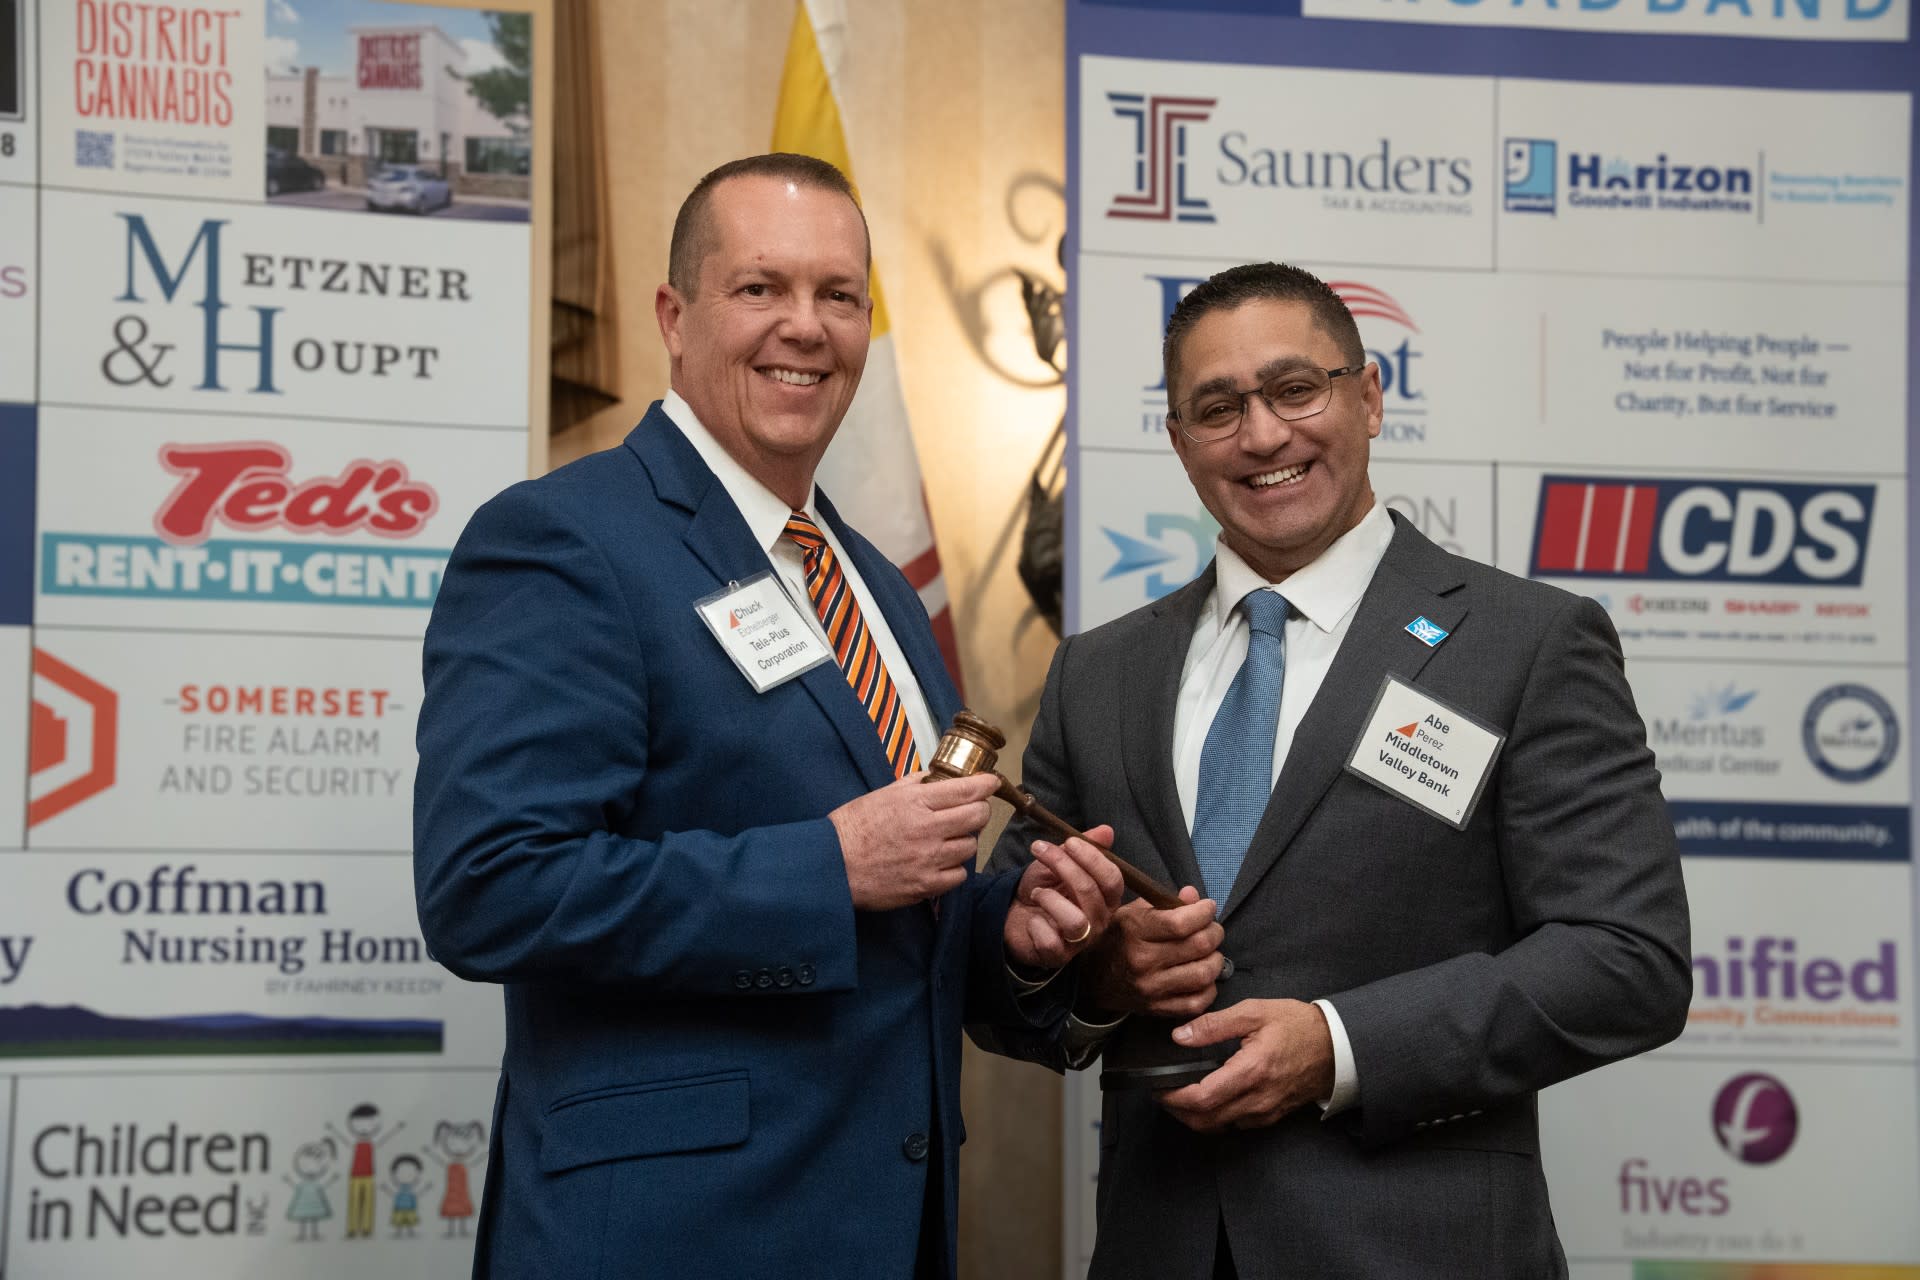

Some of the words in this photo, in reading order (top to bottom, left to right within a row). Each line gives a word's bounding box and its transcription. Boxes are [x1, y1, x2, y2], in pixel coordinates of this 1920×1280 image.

[76, 0, 234, 67] DISTRICT
[75, 58, 234, 127] CANNABIS
[1217, 131, 1473, 197] Saunders
[1569, 153, 1752, 194] Horizon
[1321, 194, 1349, 208] TAX
[1369, 197, 1473, 216] ACCOUNTING
[1568, 191, 1653, 208] Goodwill
[1657, 195, 1752, 212] Industries
[100, 314, 177, 389] &
[1602, 331, 1669, 355] People
[1674, 332, 1752, 357] Helping
[1756, 335, 1820, 360] People
[1624, 362, 1661, 381] Not
[1665, 360, 1694, 382] for
[1700, 362, 1756, 385] Profit,
[1762, 365, 1795, 385] Not
[1799, 365, 1828, 387] for
[1614, 391, 1694, 417] Charity,
[1697, 394, 1731, 414] But
[1735, 394, 1763, 415] for
[1767, 397, 1837, 418] Service
[1382, 421, 1426, 443] ION
[157, 444, 437, 542] Ted's
[1659, 487, 1865, 580] CDS
[734, 600, 764, 620] Chuck
[749, 627, 791, 652] Tele-Plus
[757, 640, 808, 670] Corporation
[179, 684, 391, 718] SOMERSET
[182, 724, 257, 755] FIRE
[266, 725, 382, 757] ALARM
[1416, 729, 1445, 751] Perez
[1424, 713, 1450, 735] Abe
[1653, 718, 1765, 748] Meritus
[1385, 731, 1459, 780] Middletown
[1655, 752, 1714, 773] edical
[1719, 754, 1781, 774] Center
[159, 764, 233, 796] AND
[243, 765, 404, 798] SECURITY
[1378, 749, 1414, 780] Valley
[1417, 770, 1452, 797] Bank
[1675, 816, 1717, 839] alth
[1718, 816, 1742, 840] of
[1743, 817, 1776, 841] the
[1777, 820, 1894, 847] community.
[65, 865, 328, 916] Coffman
[121, 926, 307, 975] Nursing
[319, 928, 436, 963] Hom
[1692, 936, 1899, 1003] nified
[1688, 1007, 1746, 1029] unity
[1753, 1005, 1900, 1028] Connections
[32, 1123, 270, 1178] Children
[1617, 1157, 1731, 1216] fives
[28, 1187, 72, 1241] in
[86, 1182, 240, 1238] Need
